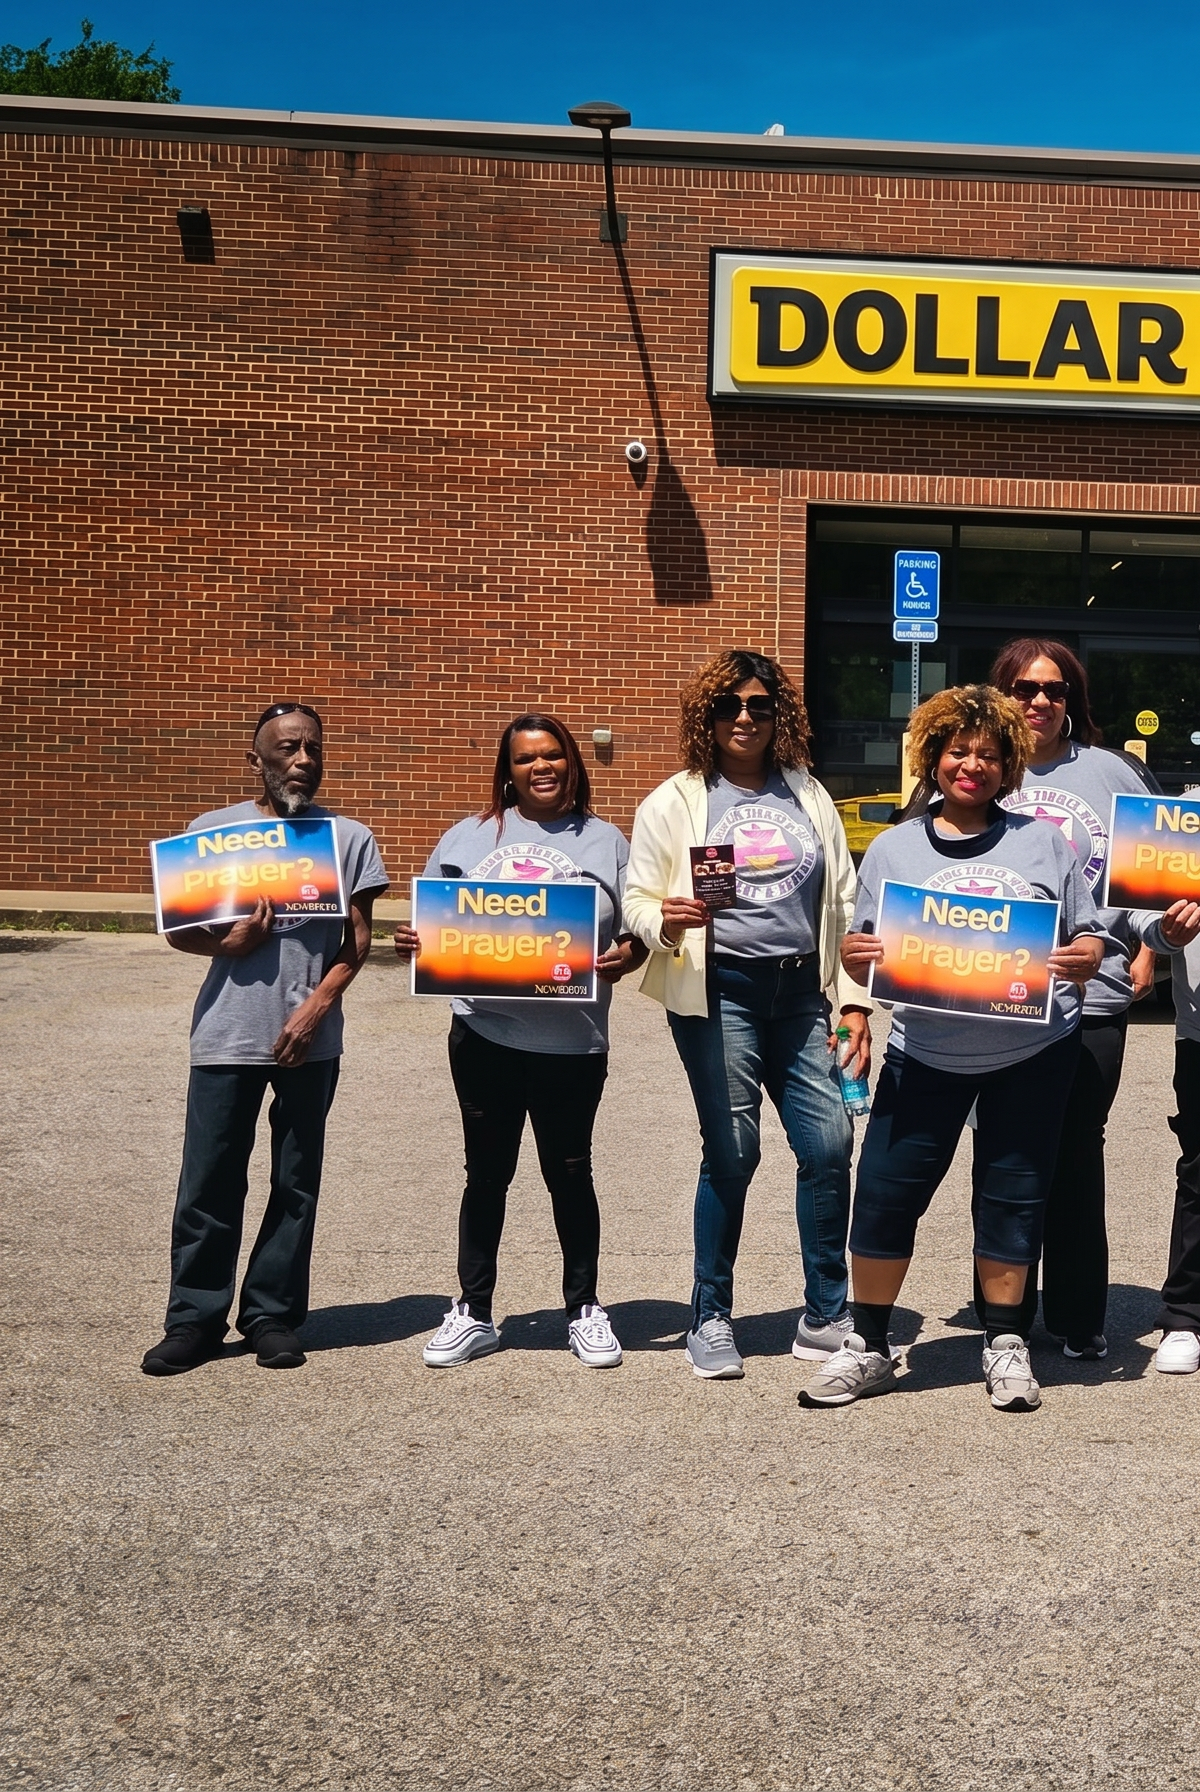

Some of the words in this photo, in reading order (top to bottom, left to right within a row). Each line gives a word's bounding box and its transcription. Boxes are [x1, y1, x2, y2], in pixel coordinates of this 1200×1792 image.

[750, 285, 1187, 384] DOLLAR
[197, 824, 287, 858] Need
[183, 857, 315, 893] Prayer?
[458, 887, 547, 917] Need
[922, 895, 1011, 933] Need
[440, 928, 572, 963] Prayer?
[900, 934, 1031, 977] Prayer?
